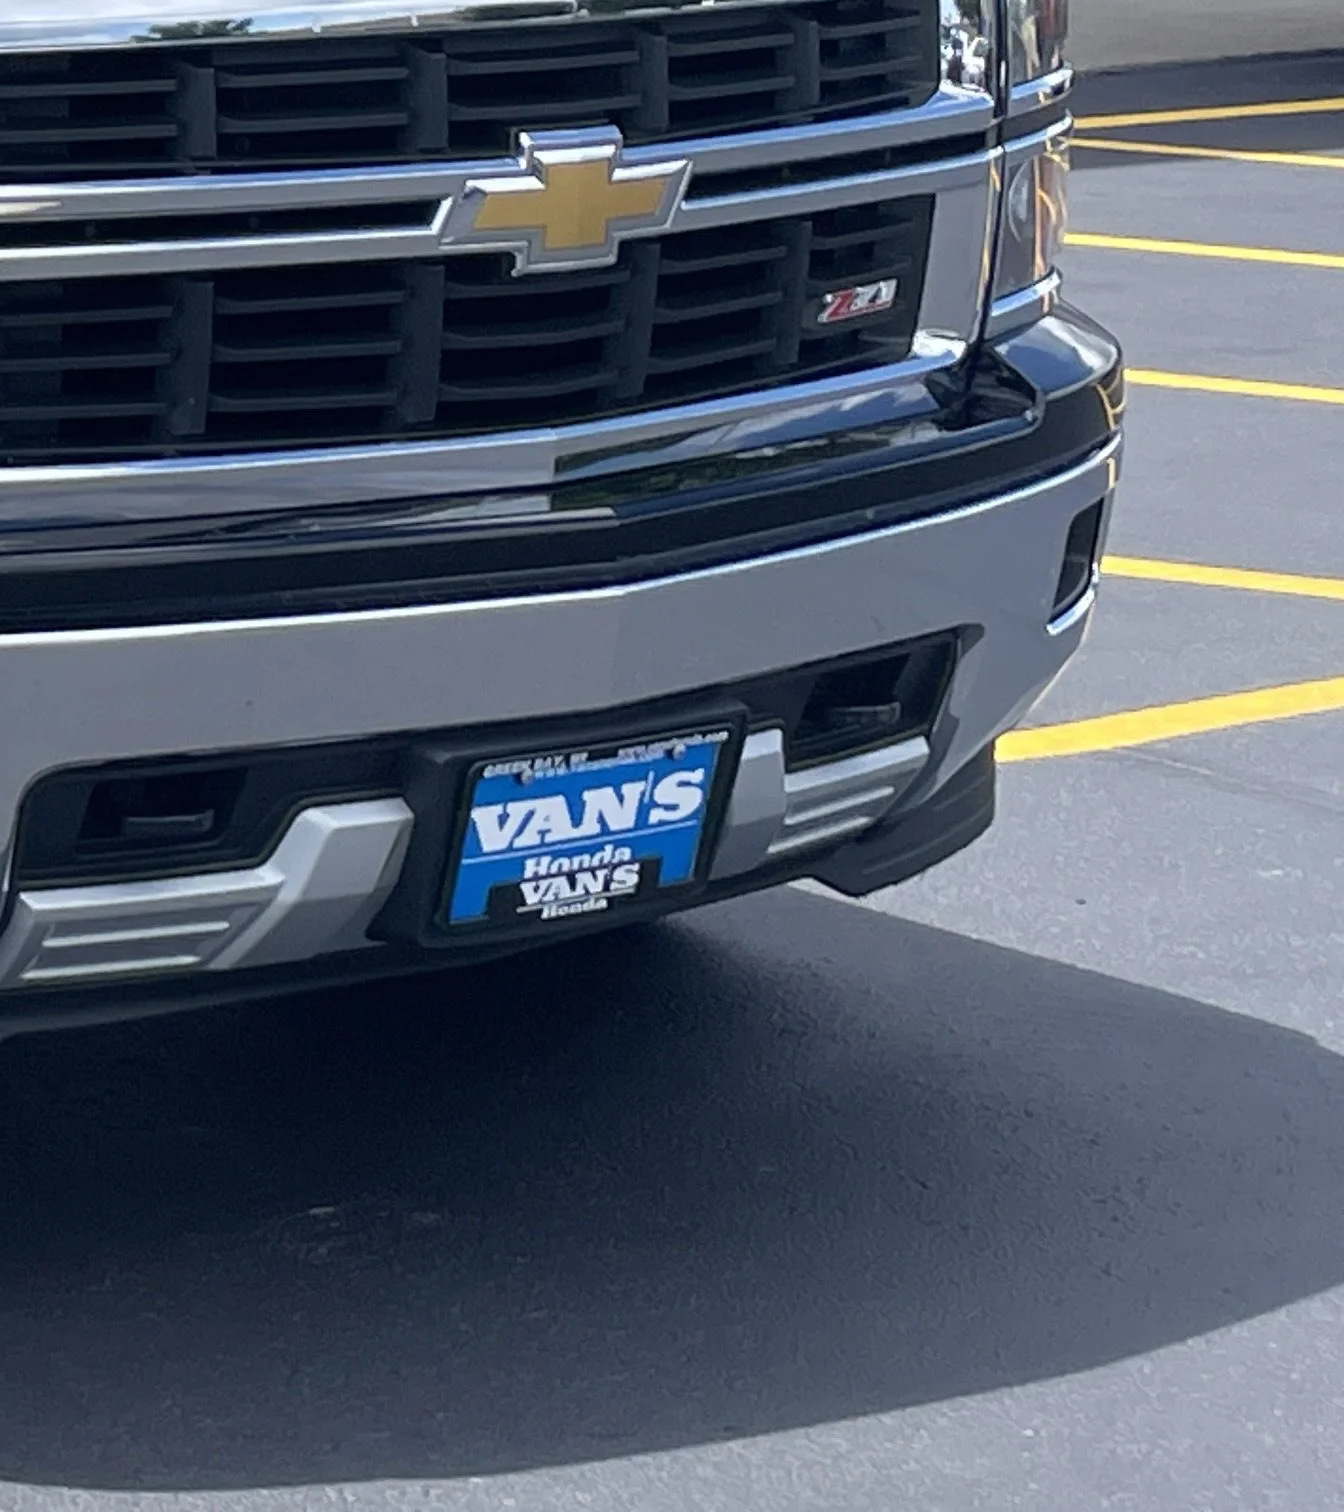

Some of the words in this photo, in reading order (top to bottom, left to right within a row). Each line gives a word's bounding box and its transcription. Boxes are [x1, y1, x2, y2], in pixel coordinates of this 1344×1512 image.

[470, 767, 705, 854] VAN'S
[523, 844, 632, 879] Honda
[520, 862, 641, 906] VAN'S
[540, 895, 609, 921] Honda
